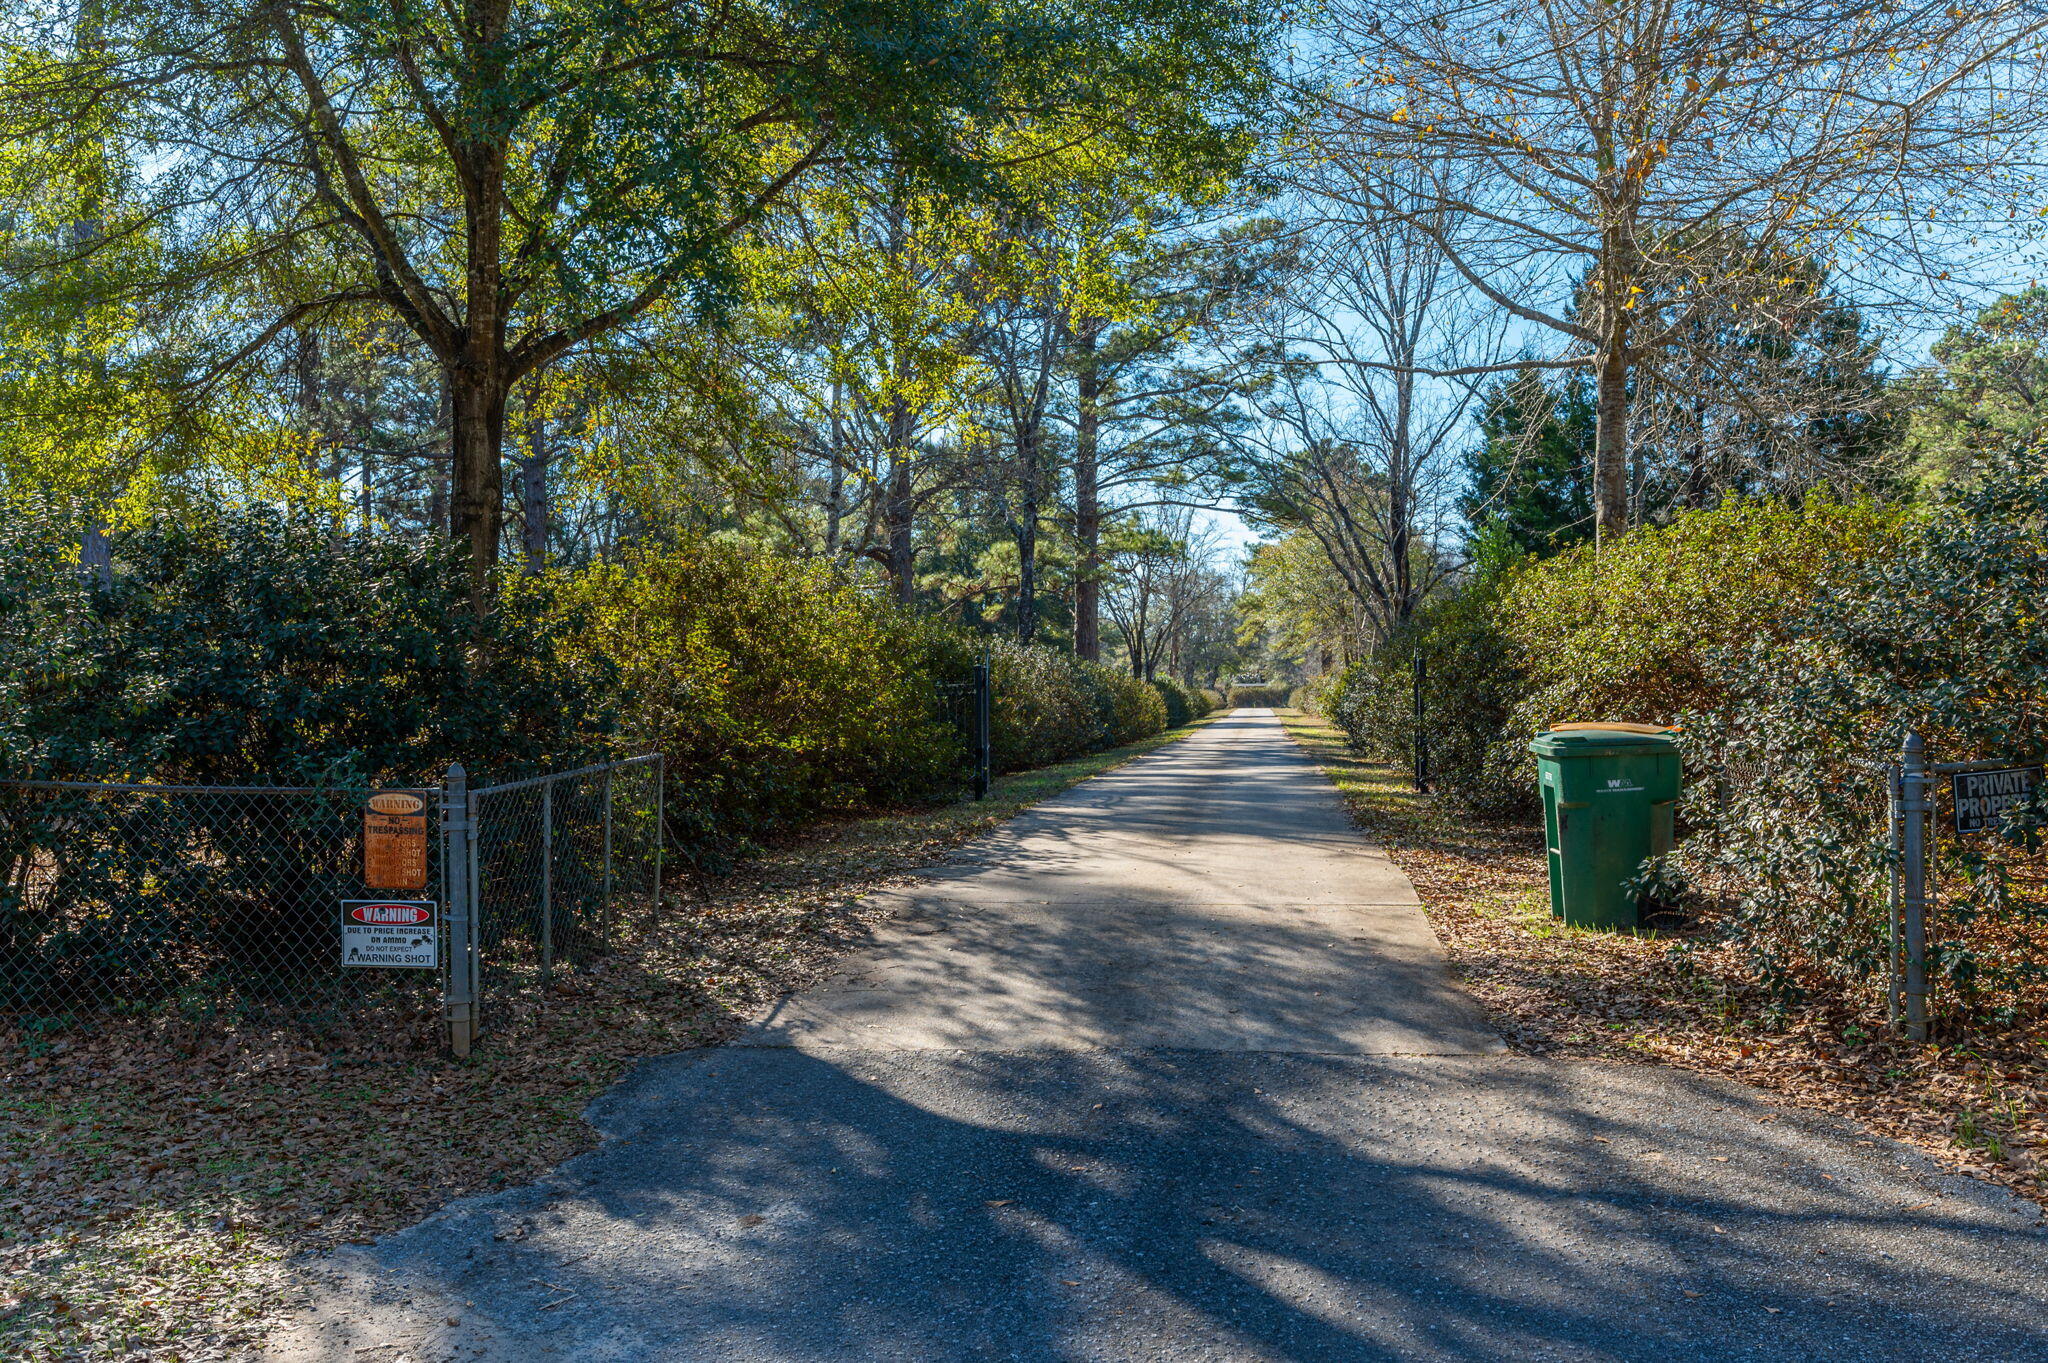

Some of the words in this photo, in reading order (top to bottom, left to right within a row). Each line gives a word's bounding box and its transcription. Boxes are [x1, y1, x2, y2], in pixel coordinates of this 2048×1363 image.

[1966, 771, 2031, 797] PRIVATE
[371, 799, 420, 809] WARNING
[388, 816, 400, 825] NO
[1968, 817, 1981, 828] NO
[368, 825, 423, 835] TRESPASSING
[401, 868, 422, 877] SHOT
[363, 908, 418, 922] WARNING
[374, 927, 395, 935] PRICE
[371, 936, 381, 944] ON
[348, 953, 355, 962] A
[358, 954, 402, 963] WARNING
[405, 954, 432, 963] SHOT
